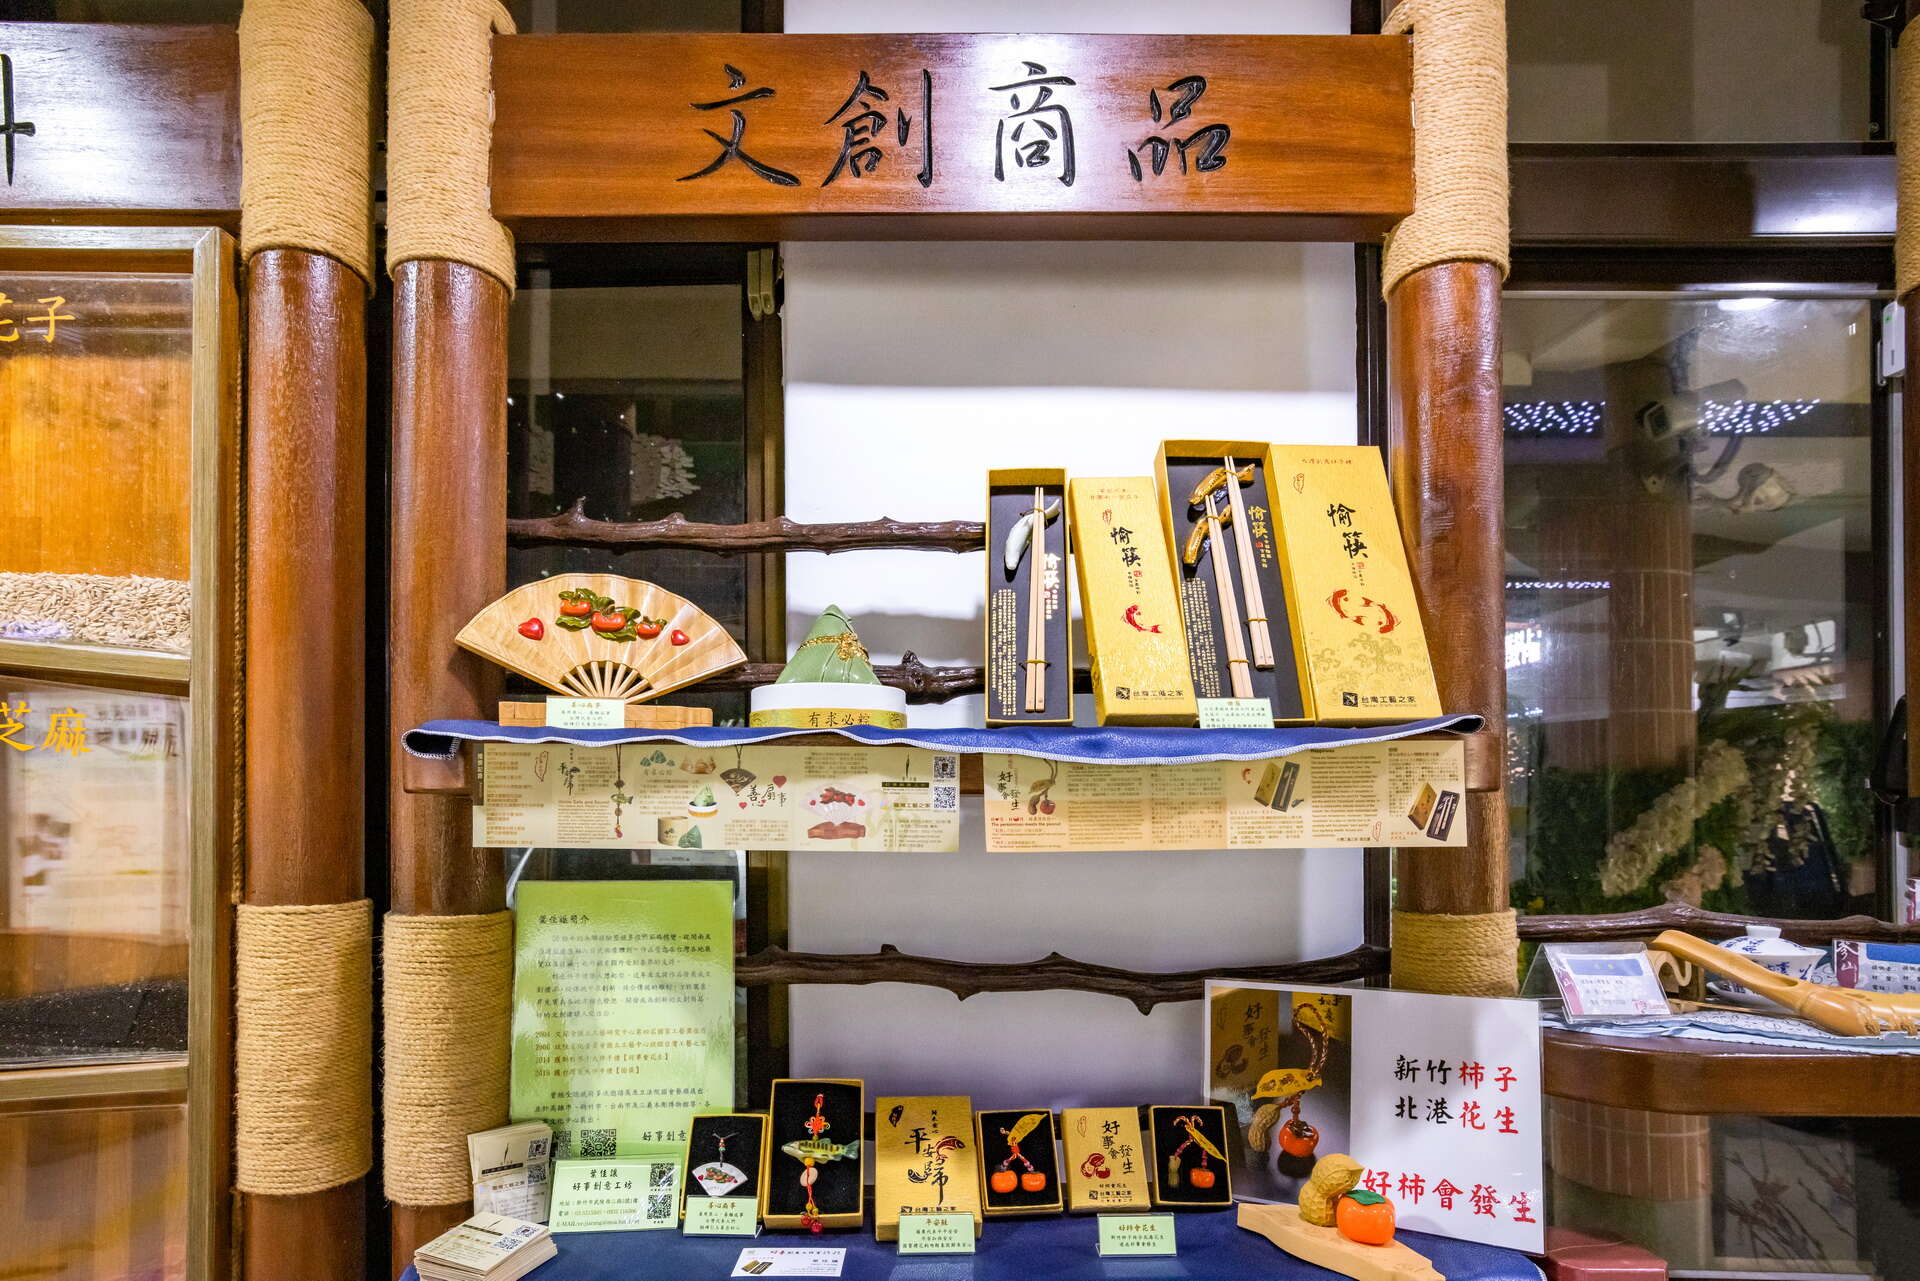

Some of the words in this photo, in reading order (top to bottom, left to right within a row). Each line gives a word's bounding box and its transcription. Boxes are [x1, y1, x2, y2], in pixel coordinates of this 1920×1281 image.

[676, 61, 1231, 188] 文創商品
[1109, 526, 1142, 567] 愉筷
[1327, 503, 1368, 559] 愉筷
[0, 701, 92, 756] 芝麻
[1393, 1055, 1518, 1093] 新竹柿子
[1394, 1096, 1520, 1135] 北港花生
[572, 1180, 633, 1191] 好事創意工坊
[1362, 1168, 1537, 1224] 好柿會發生
